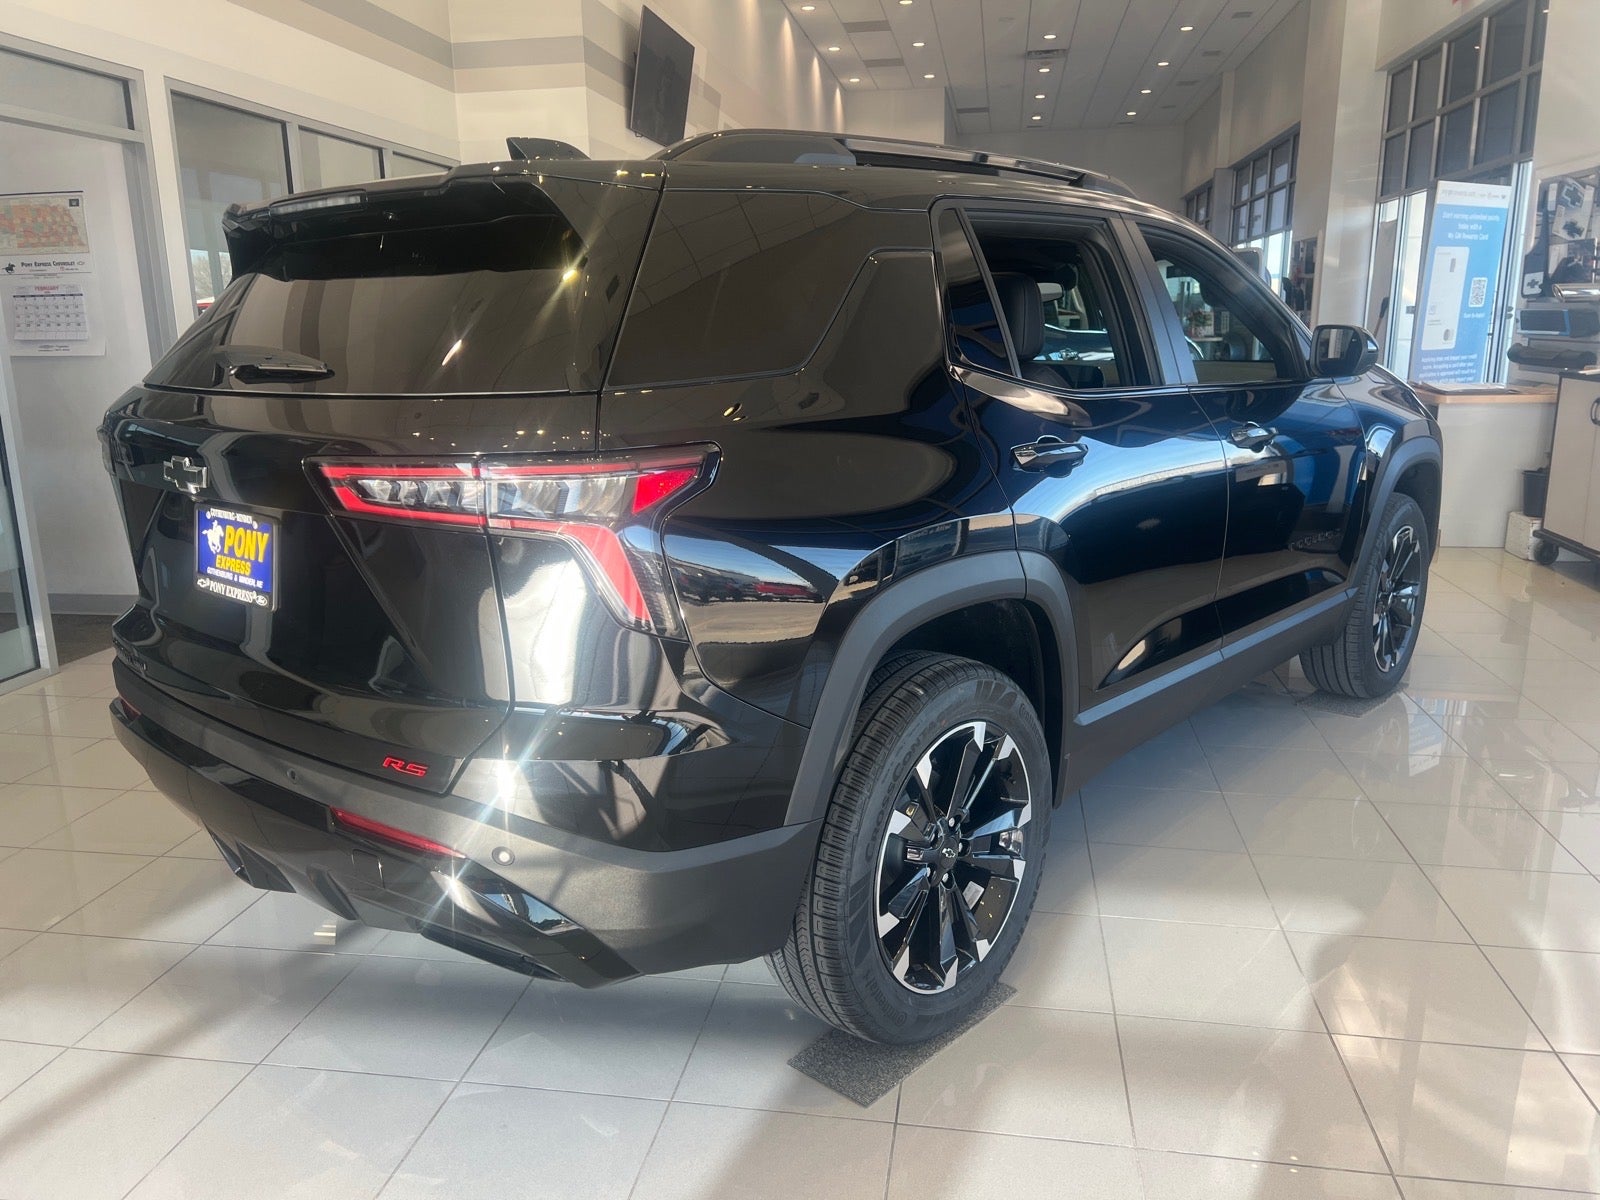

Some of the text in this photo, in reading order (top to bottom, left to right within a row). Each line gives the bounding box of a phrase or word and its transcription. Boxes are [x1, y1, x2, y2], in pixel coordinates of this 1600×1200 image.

[224, 525, 269, 563] PONY
[216, 554, 251, 576] EXPRESS
[209, 580, 226, 595] PONY
[226, 583, 253, 603] EXPRESS
[383, 757, 428, 776] RS
